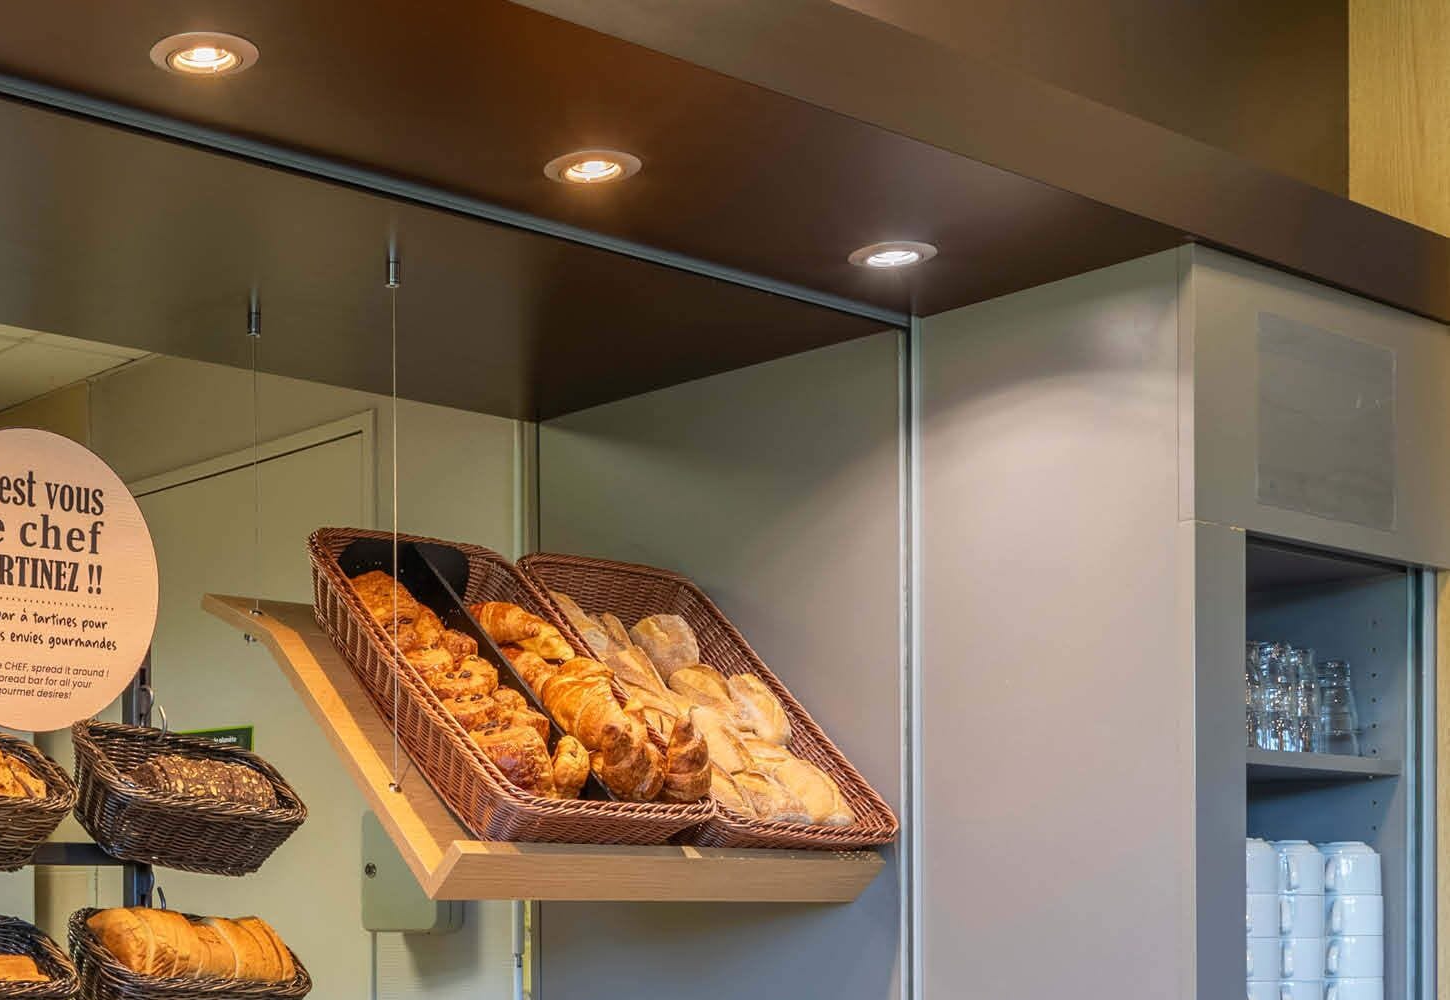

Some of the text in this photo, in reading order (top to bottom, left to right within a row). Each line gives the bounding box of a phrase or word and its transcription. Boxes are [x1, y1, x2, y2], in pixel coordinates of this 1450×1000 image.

[45, 481, 104, 516] vous
[19, 514, 104, 555] chef
[20, 608, 28, 622] à
[33, 613, 78, 628] tartines
[82, 618, 108, 632] pour
[10, 632, 44, 645] envies
[49, 635, 118, 651] gourmandes
[4, 661, 30, 672] CHEF,
[31, 663, 63, 675] spread
[65, 666, 71, 675] it
[72, 667, 104, 677] around
[28, 675, 43, 685] bar
[45, 677, 57, 687] for
[59, 678, 71, 688] all
[72, 680, 93, 690] your
[36, 689, 72, 700] desires!
